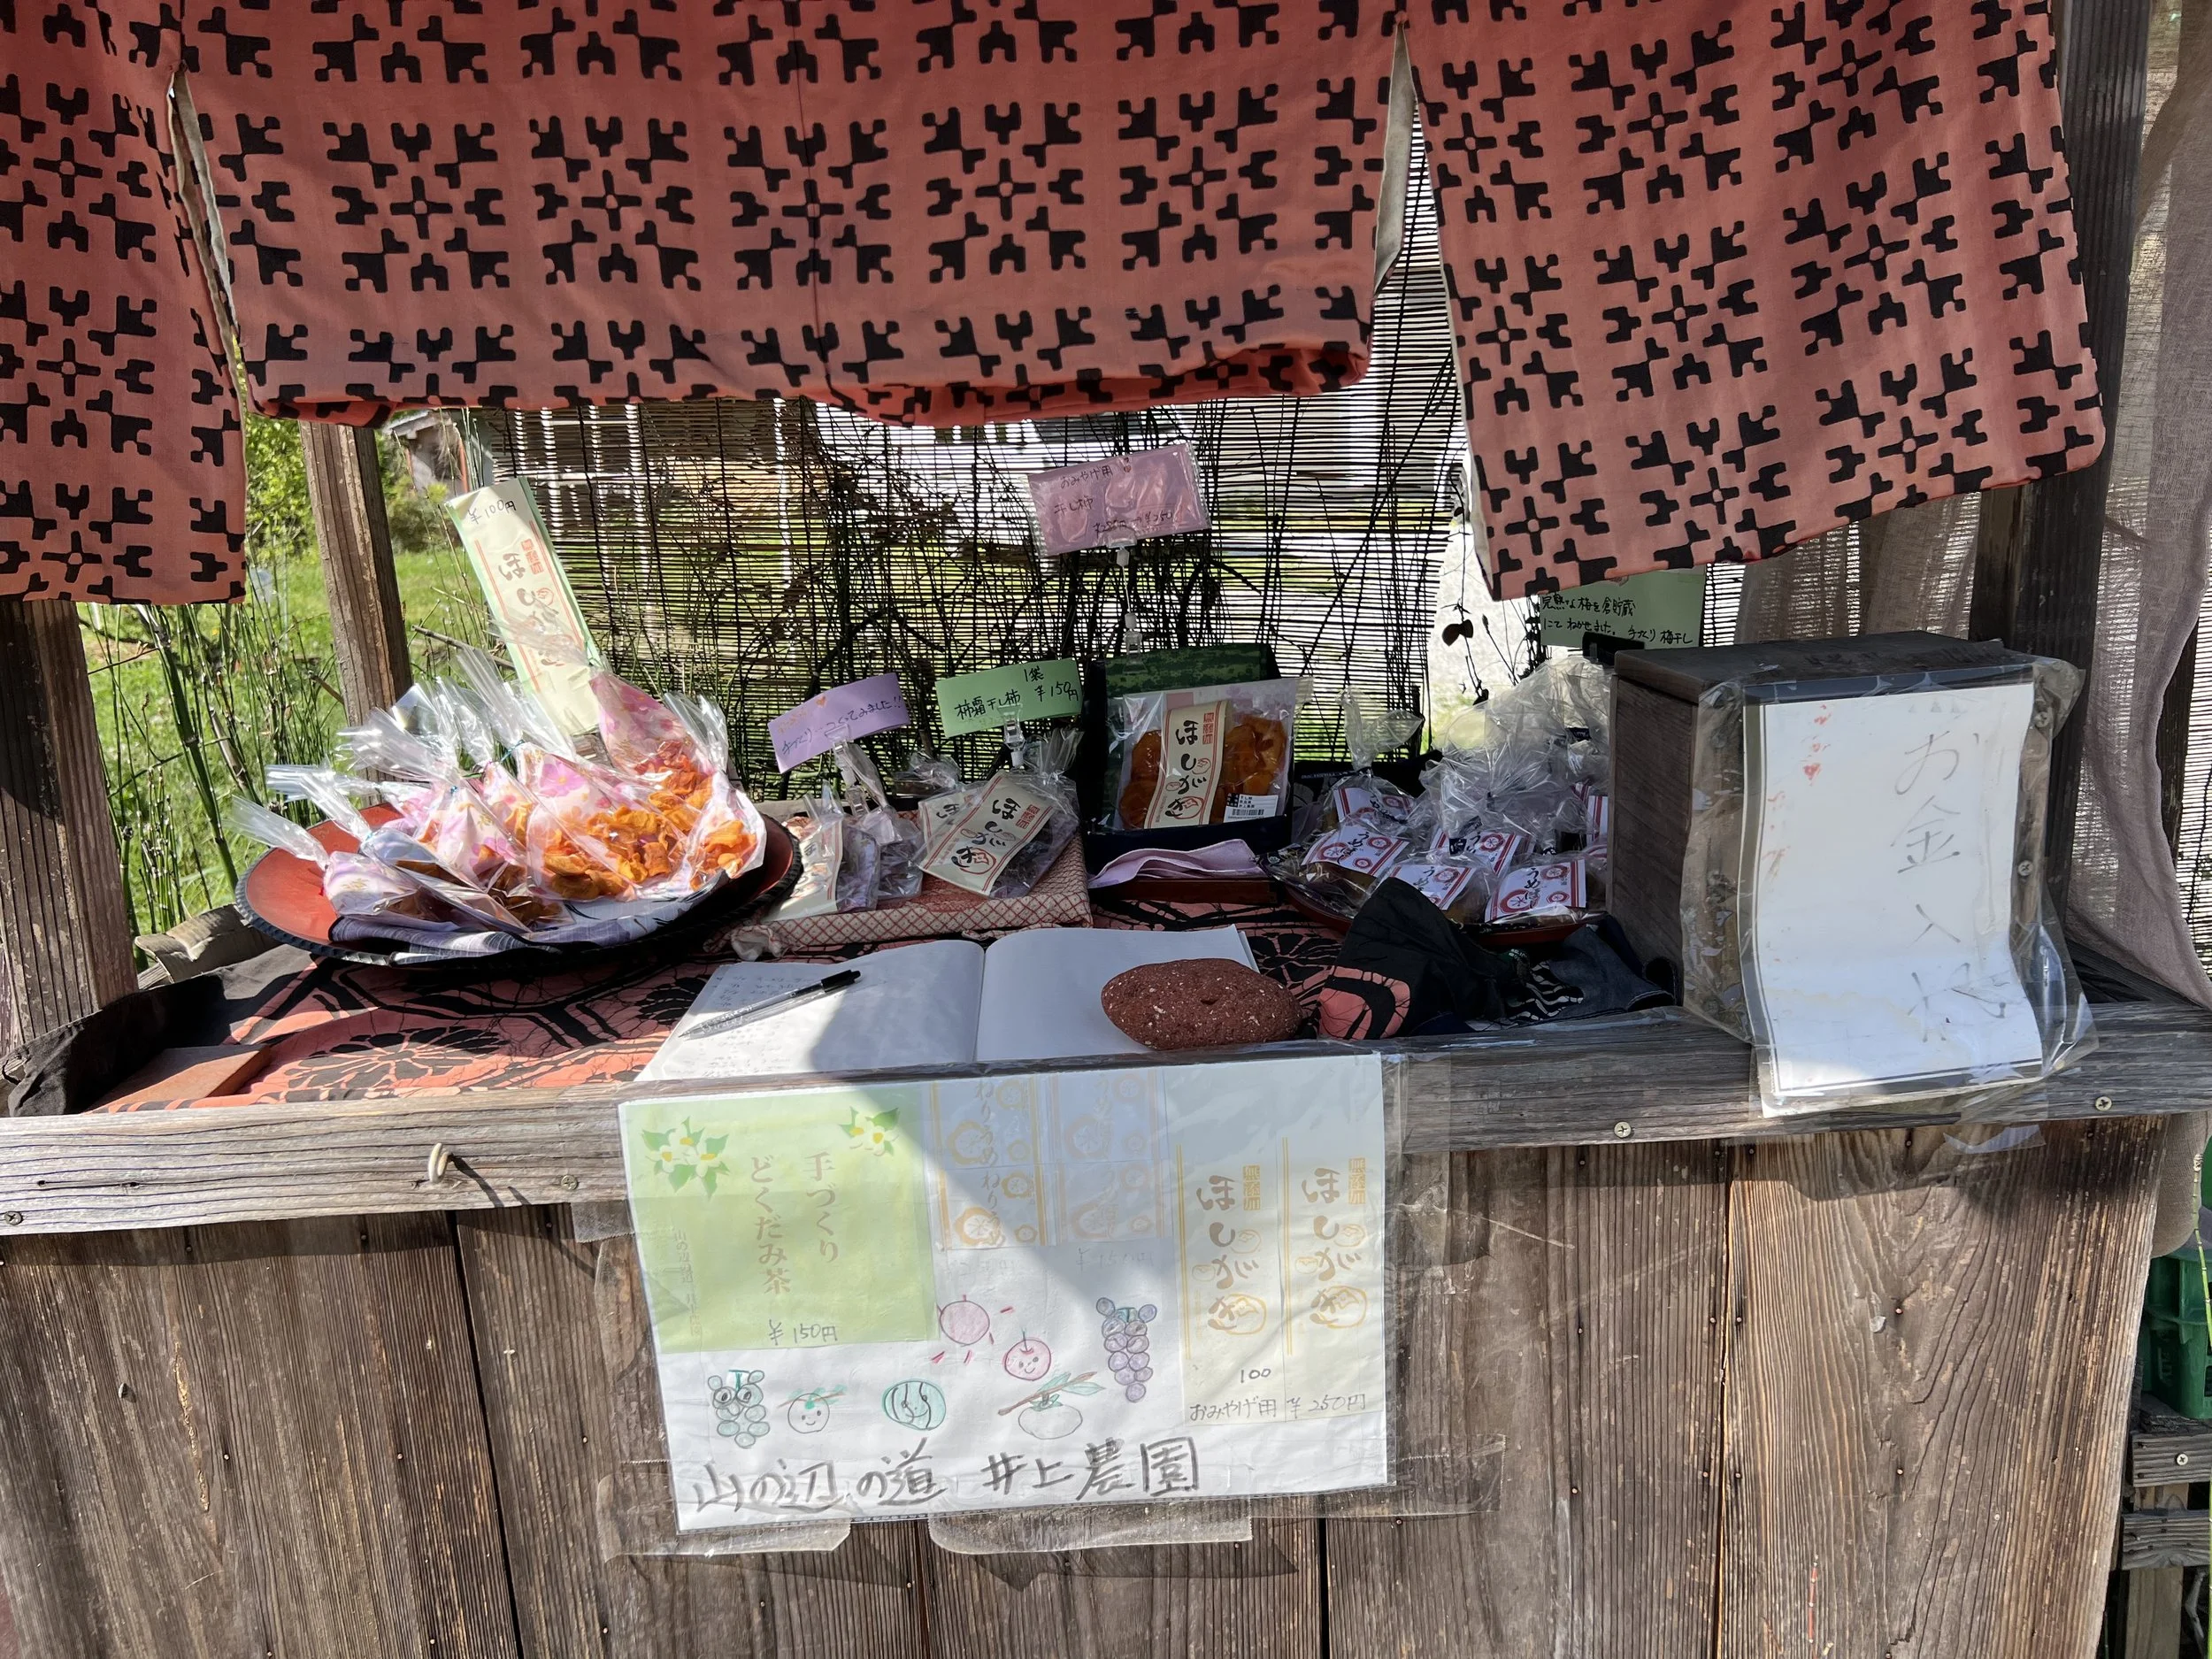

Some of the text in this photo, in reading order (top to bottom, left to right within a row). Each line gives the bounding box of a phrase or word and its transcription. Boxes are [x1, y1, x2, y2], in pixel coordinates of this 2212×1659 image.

[1164, 719, 1208, 819] ほしがき
[749, 1156, 793, 1297] どくだみ茶
[803, 1150, 841, 1265] 手づくり
[1195, 1174, 1260, 1332] ほしがき
[1301, 1167, 1363, 1325] ほしがき
[1239, 1367, 1272, 1384] 100
[693, 1434, 1201, 1515] 山の辺の道 井上農園
